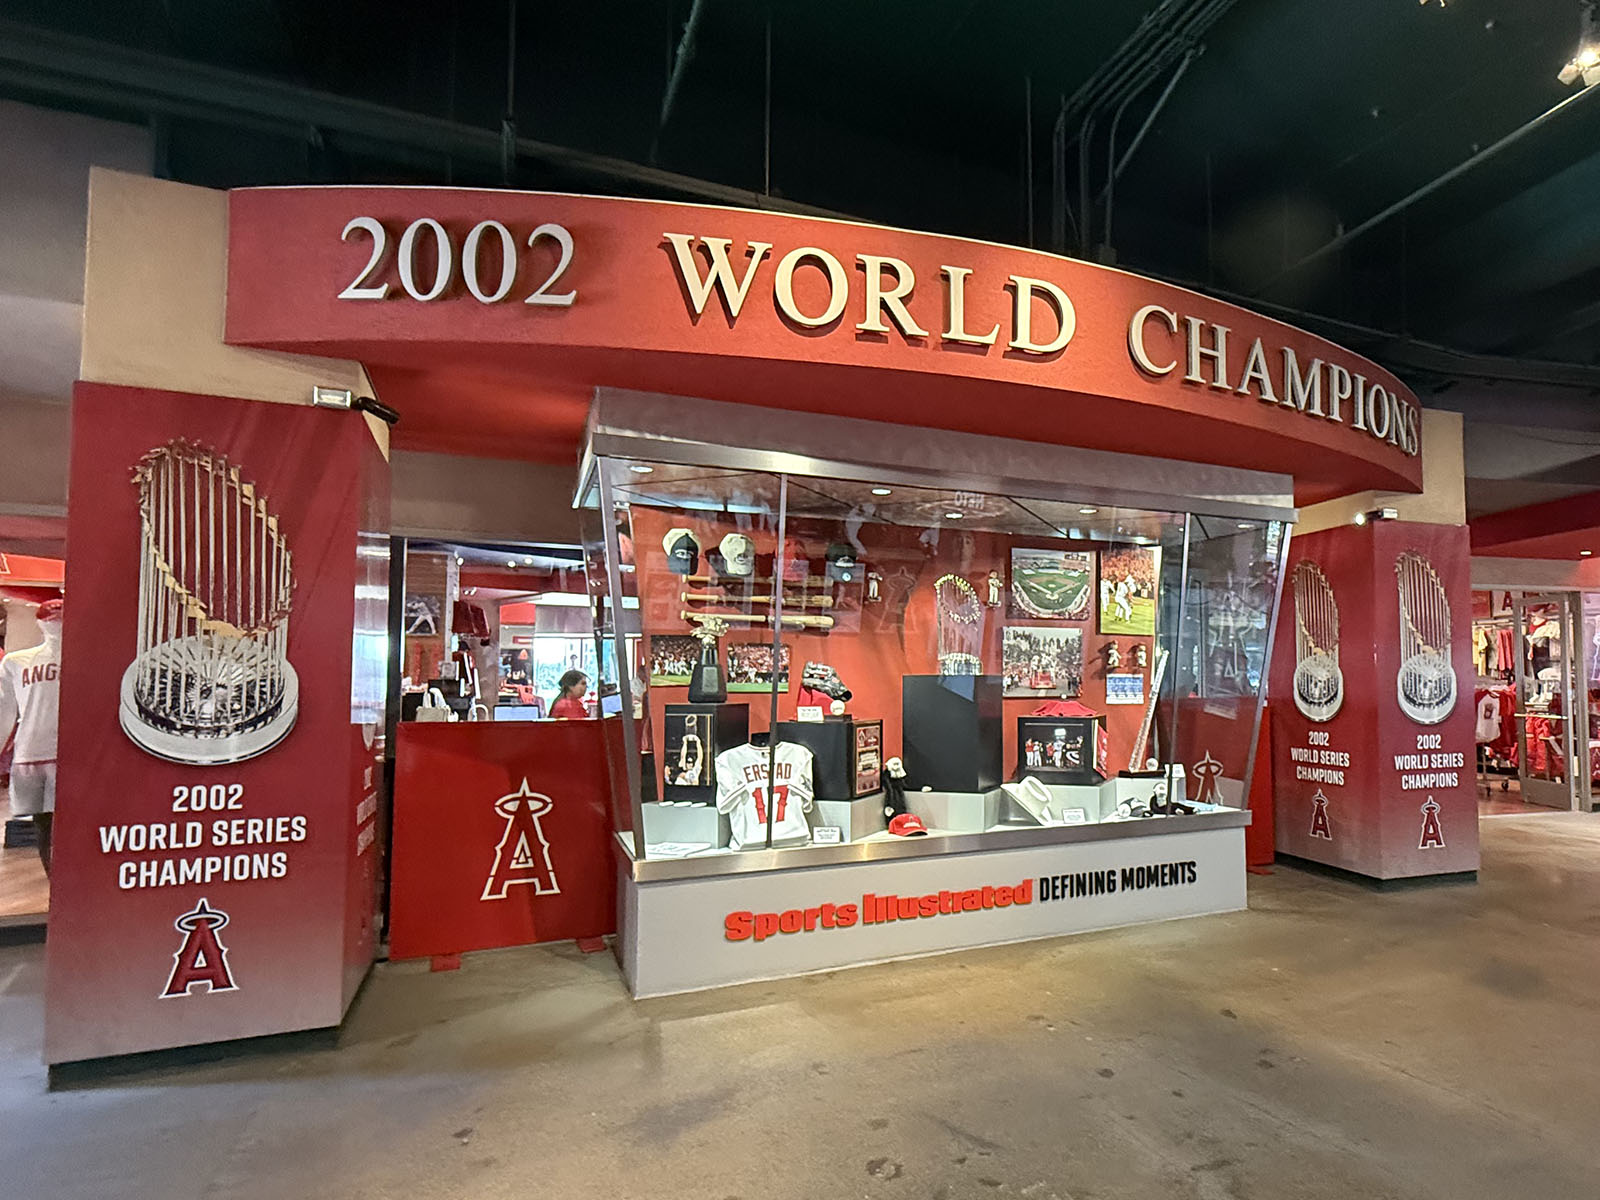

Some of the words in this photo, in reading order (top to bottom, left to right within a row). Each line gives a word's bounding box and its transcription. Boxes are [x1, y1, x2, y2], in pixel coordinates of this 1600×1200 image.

[338, 216, 577, 307] 2002
[662, 232, 1077, 353] WORLD
[1128, 304, 1420, 456] CHAMPIONS
[22, 662, 61, 689] ANG
[1308, 730, 1330, 747] 2002
[1416, 734, 1442, 750] 2002
[743, 762, 793, 784] ERSAD
[1290, 747, 1319, 764] WORLD
[1320, 750, 1350, 768] SERIES
[1394, 754, 1429, 771] WORLD
[1430, 752, 1464, 769] SERIES
[1296, 765, 1345, 787] CHAMPIONS
[1401, 772, 1459, 791] CHAMPIONS
[172, 783, 244, 813] 2002
[752, 784, 790, 825] 17
[1310, 788, 1333, 841] A
[99, 821, 203, 854] WORLD
[211, 815, 307, 847] SERIES
[480, 776, 561, 901] A
[1418, 795, 1446, 850] A
[118, 851, 288, 890] CHAMPIONS
[724, 902, 858, 942] Sports
[862, 878, 1034, 926] Illustrated
[1039, 869, 1117, 903] DEFINING
[1120, 860, 1197, 892] MOMENTS
[158, 897, 240, 999] A
